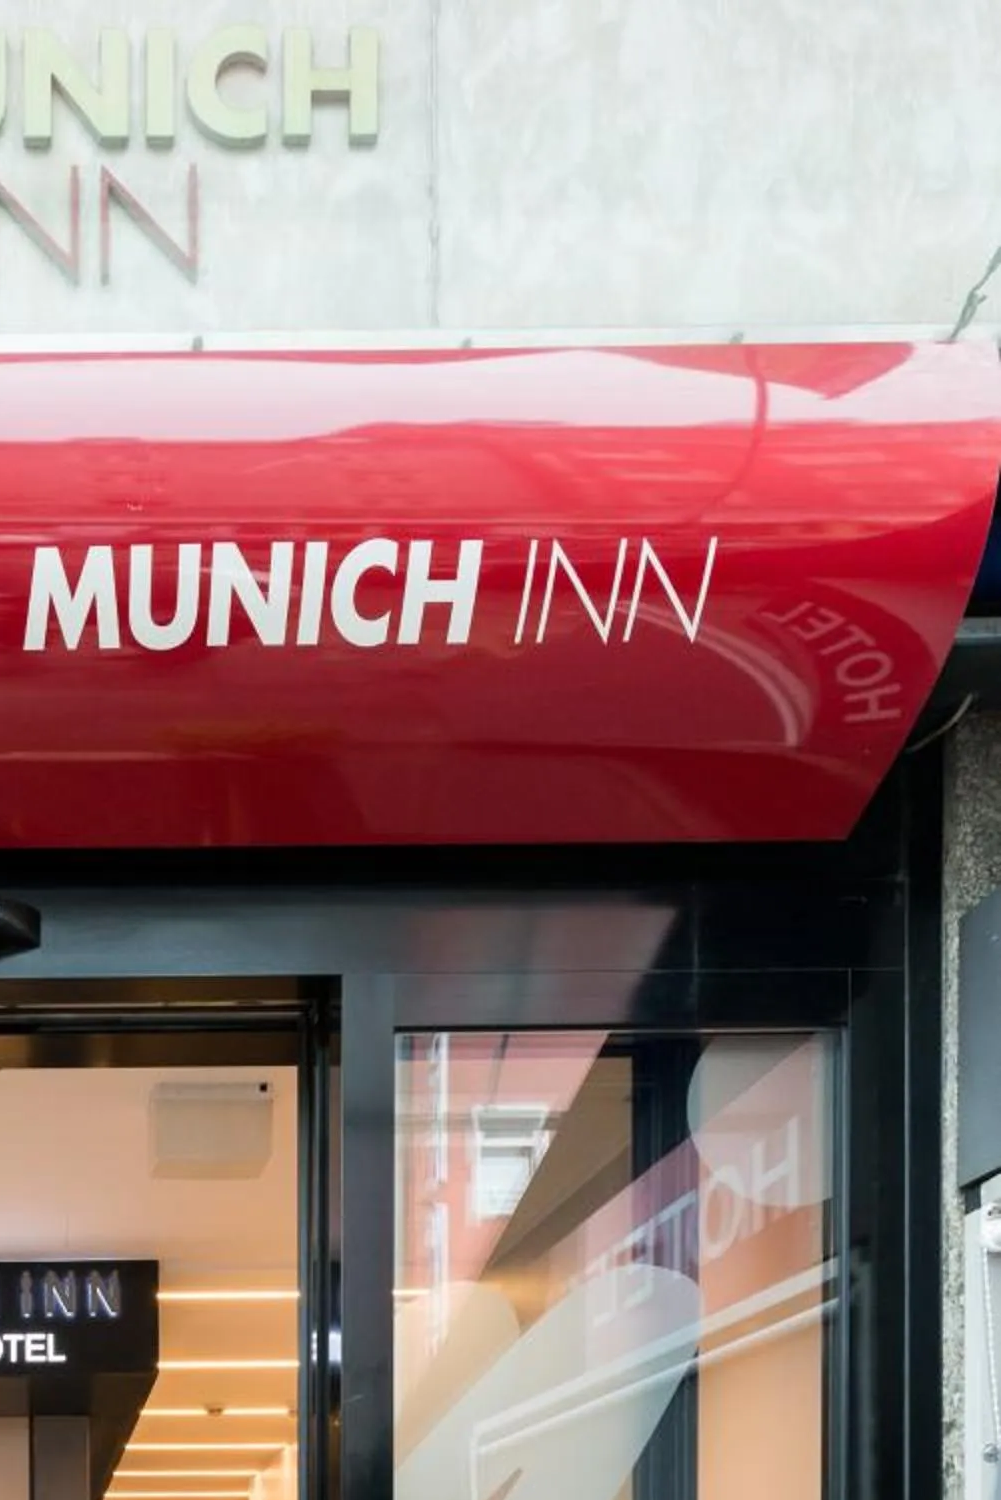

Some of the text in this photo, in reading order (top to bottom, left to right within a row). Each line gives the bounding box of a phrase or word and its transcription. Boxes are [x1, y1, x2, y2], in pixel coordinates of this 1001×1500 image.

[23, 538, 484, 652] MUNICH
[514, 537, 718, 646] INN
[19, 1269, 121, 1319] INN
